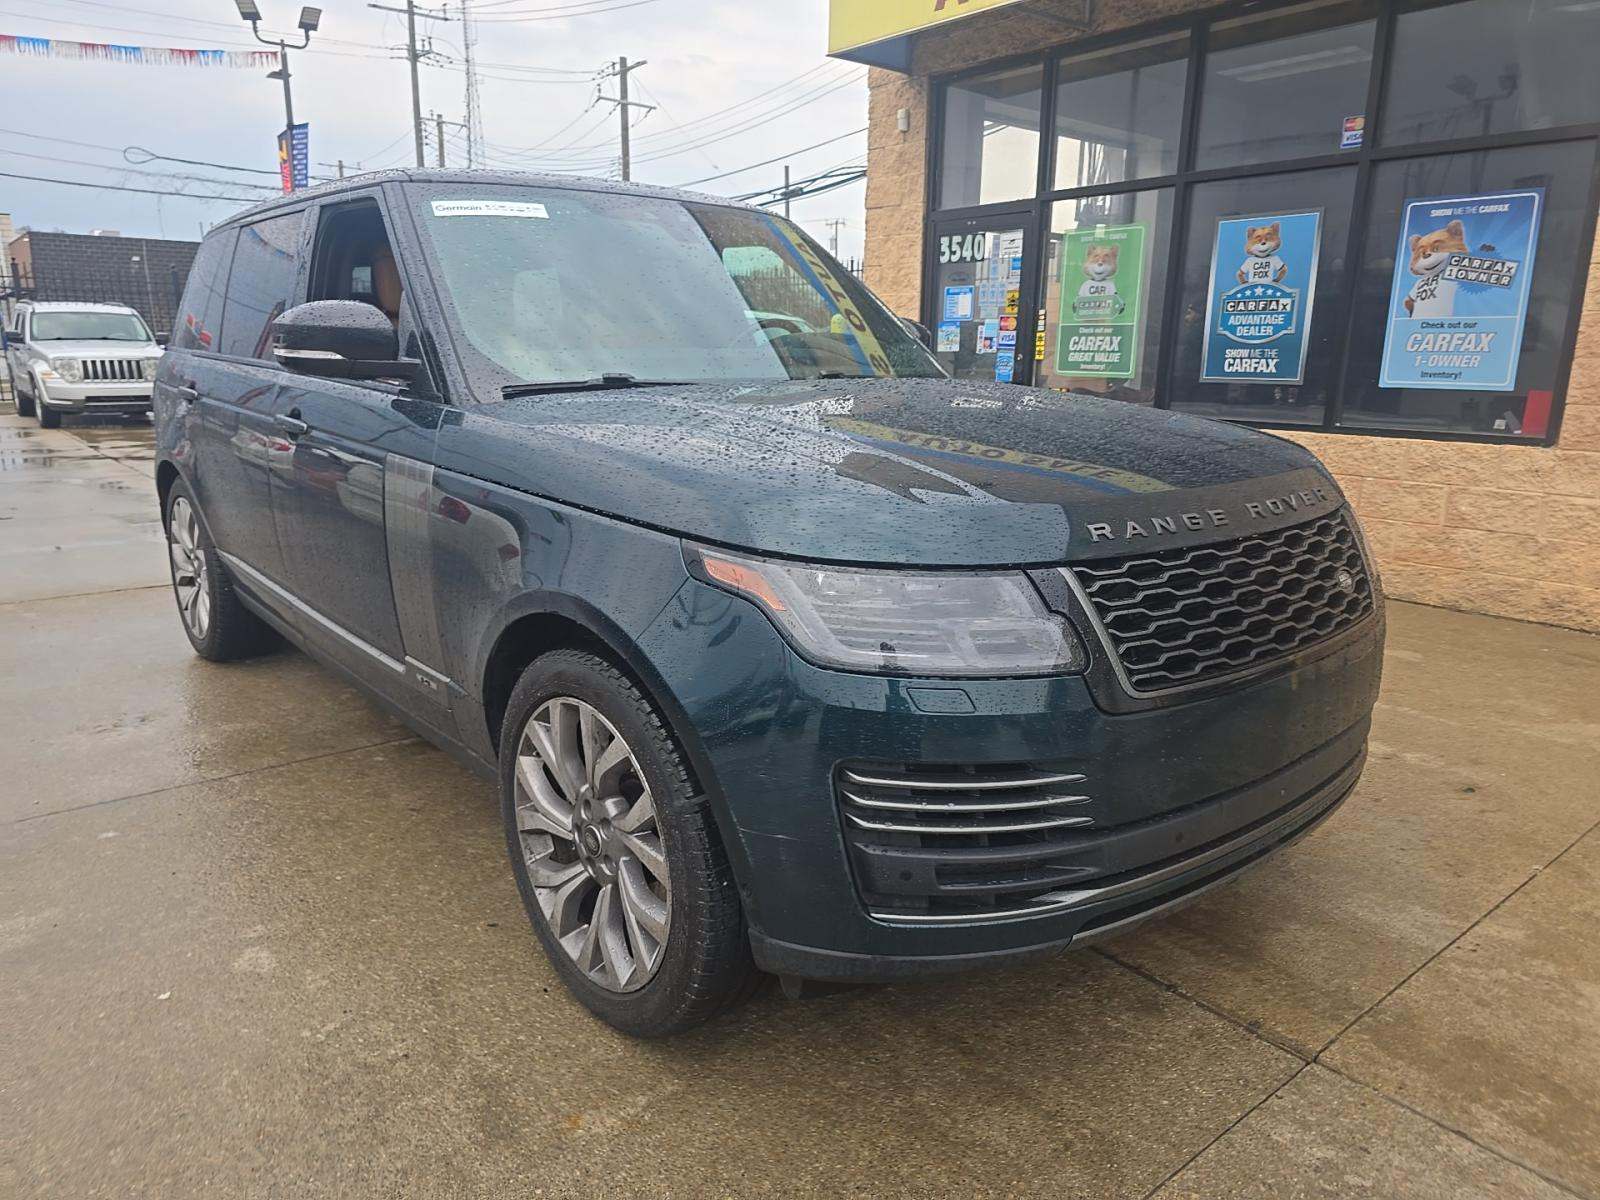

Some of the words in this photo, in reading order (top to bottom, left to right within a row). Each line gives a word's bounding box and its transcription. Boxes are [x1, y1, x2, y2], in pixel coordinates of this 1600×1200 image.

[1478, 204, 1510, 213] CARFAX
[939, 234, 985, 264] 3540
[1253, 262, 1270, 270] CAR
[1450, 255, 1516, 274] CARFAX
[1252, 270, 1270, 279] FOX
[1417, 274, 1440, 290] CAR
[1089, 286, 1106, 295] CAR
[1416, 286, 1438, 300] FOX
[1226, 300, 1290, 312] CARFAX
[1228, 314, 1285, 325] ADVANTAGE
[1079, 326, 1094, 334] Check
[1236, 326, 1273, 336] DEALER
[1420, 321, 1445, 330] Check
[1447, 321, 1462, 330] out
[1069, 336, 1122, 351] CARFAX
[1406, 332, 1495, 352] CARFAX
[1068, 352, 1094, 362] GREAT
[1094, 352, 1121, 362] VALUE
[1224, 348, 1250, 358] SHOW
[1250, 349, 1263, 358] ME
[1264, 348, 1279, 358] THE
[1224, 358, 1280, 373] CARFAX
[1414, 354, 1481, 368] 1-OWNER
[1420, 370, 1462, 380] Inventory!
[1086, 508, 1229, 542] RANGE
[1246, 488, 1328, 519] ROVER
